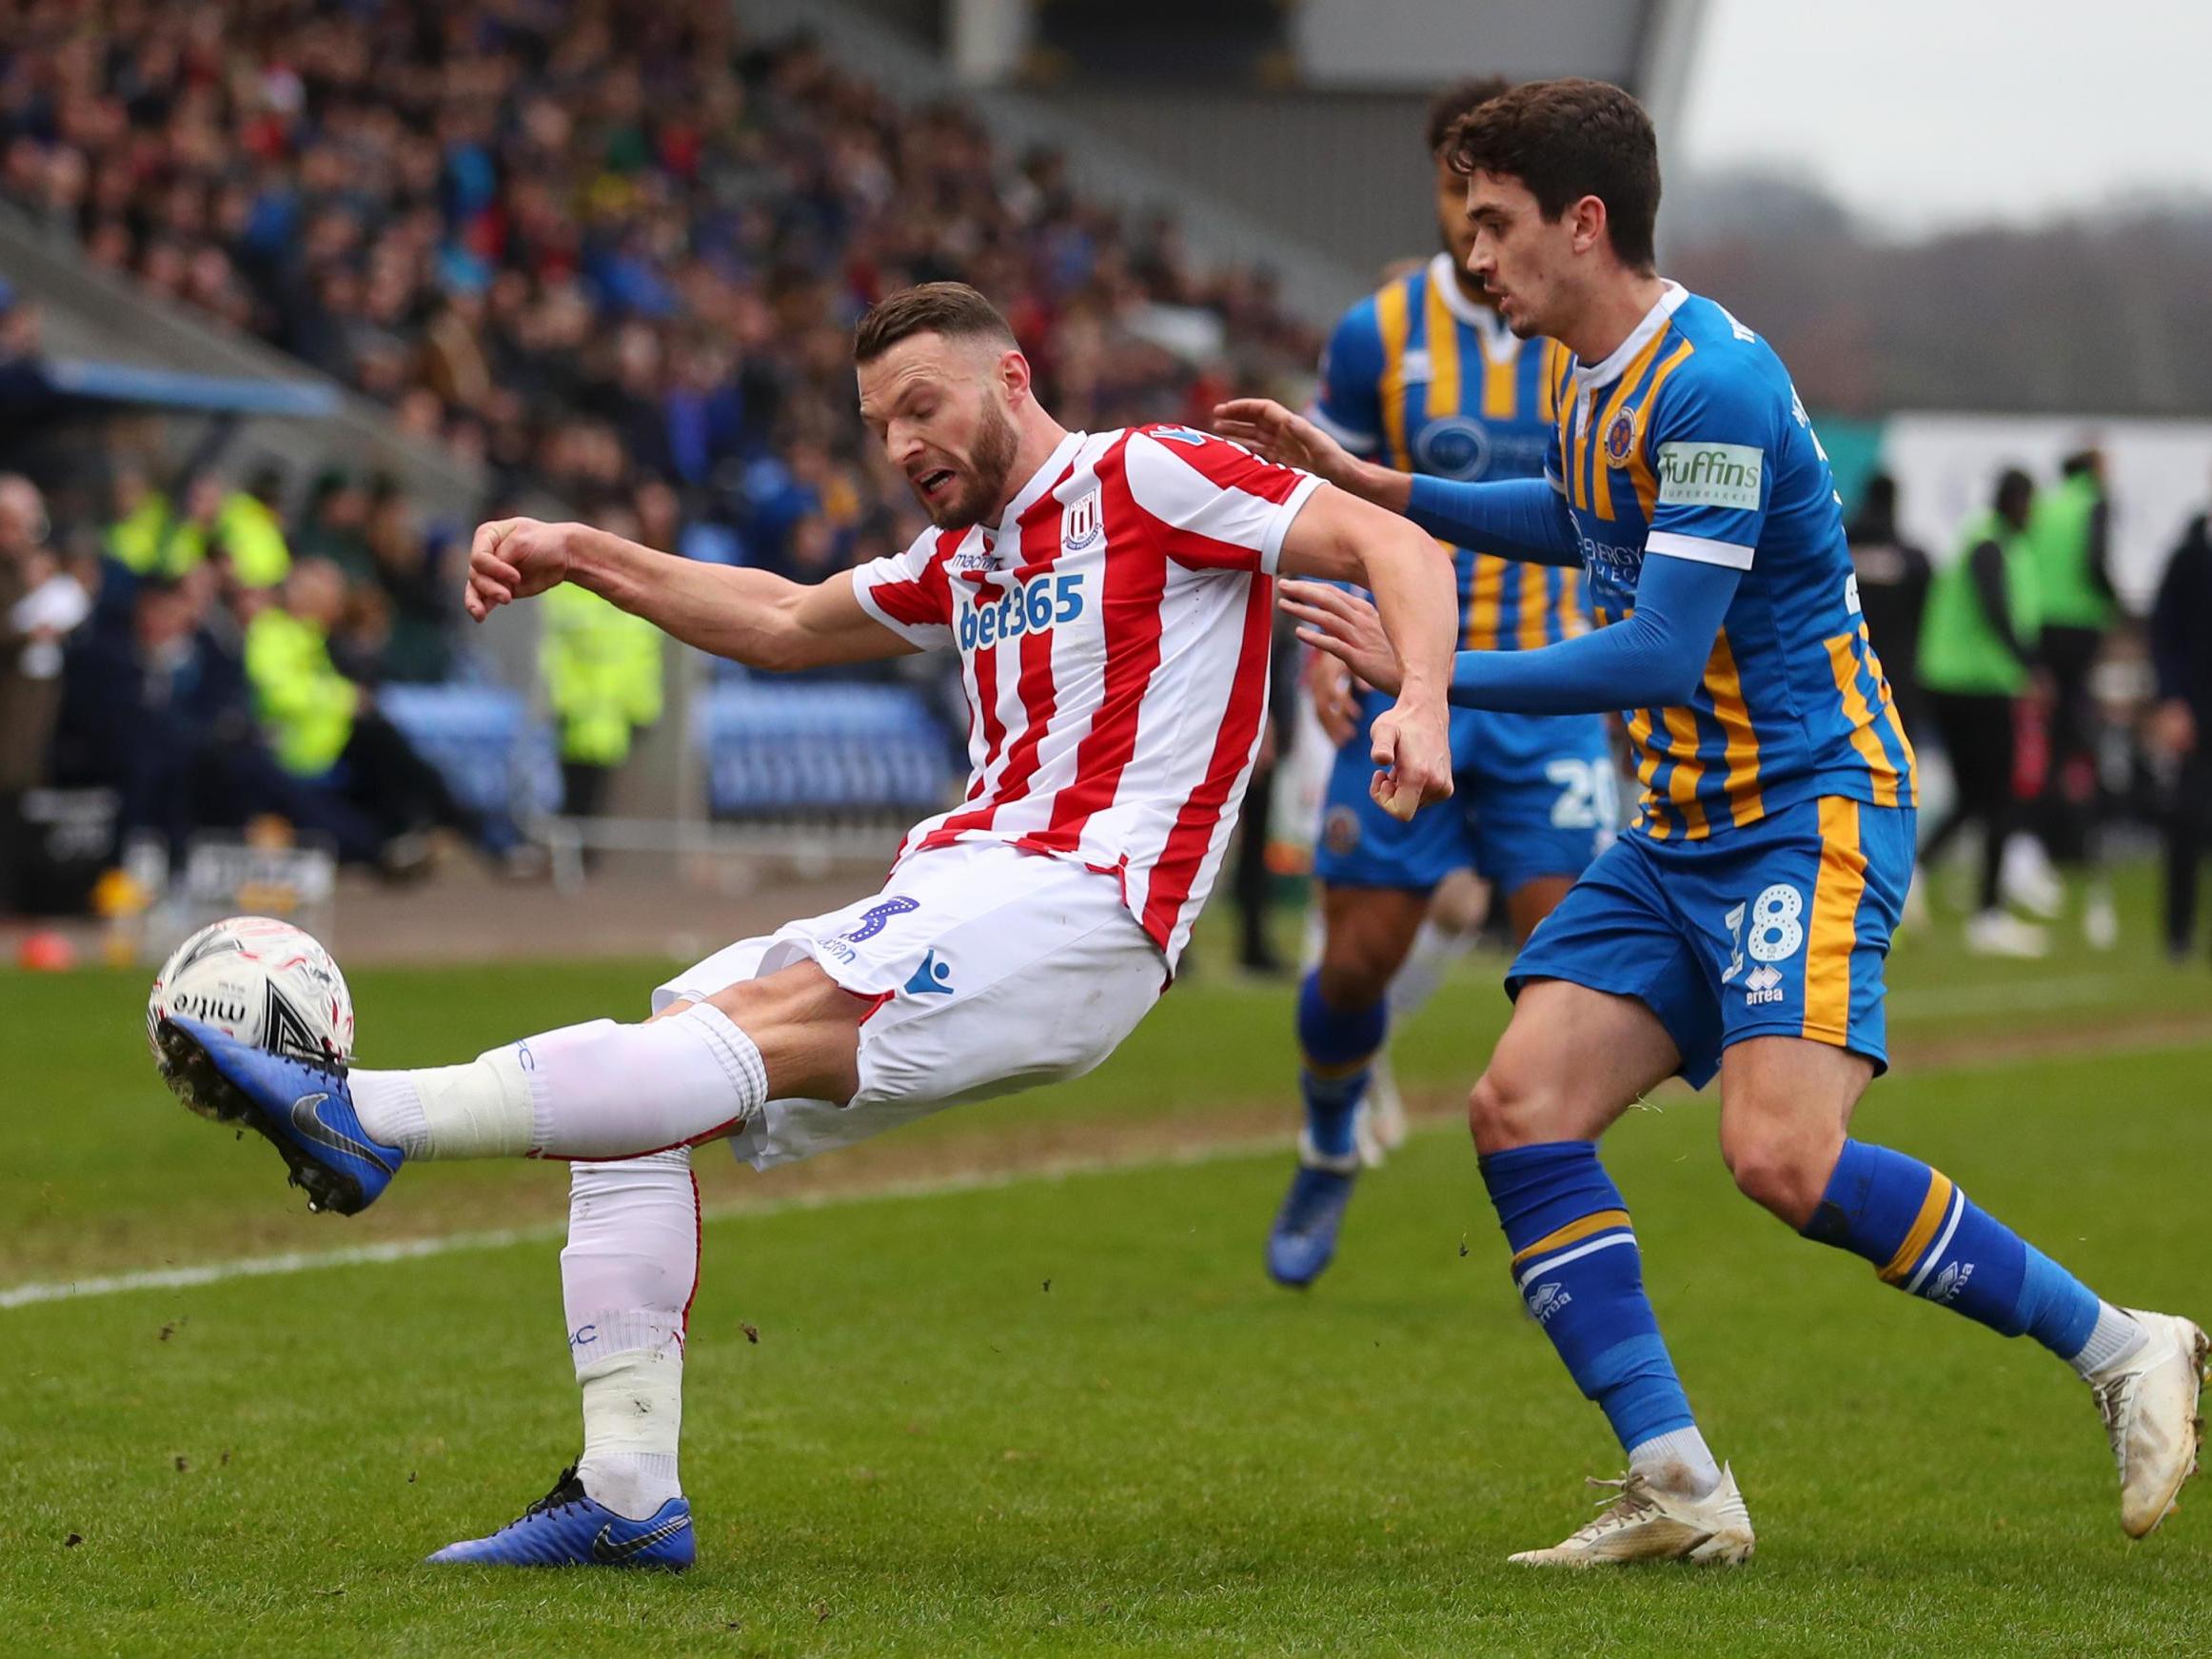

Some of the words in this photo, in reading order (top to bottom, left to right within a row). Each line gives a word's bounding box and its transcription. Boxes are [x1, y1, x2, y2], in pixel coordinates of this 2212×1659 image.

[1663, 451, 1759, 488] Tuffins
[959, 574, 1084, 651] bet365
[819, 935, 856, 965] acron
[1722, 883, 1804, 984] 18
[174, 994, 246, 1022] mitre
[1943, 1262, 1975, 1301] rrea
[1539, 1292, 1572, 1324] rrea
